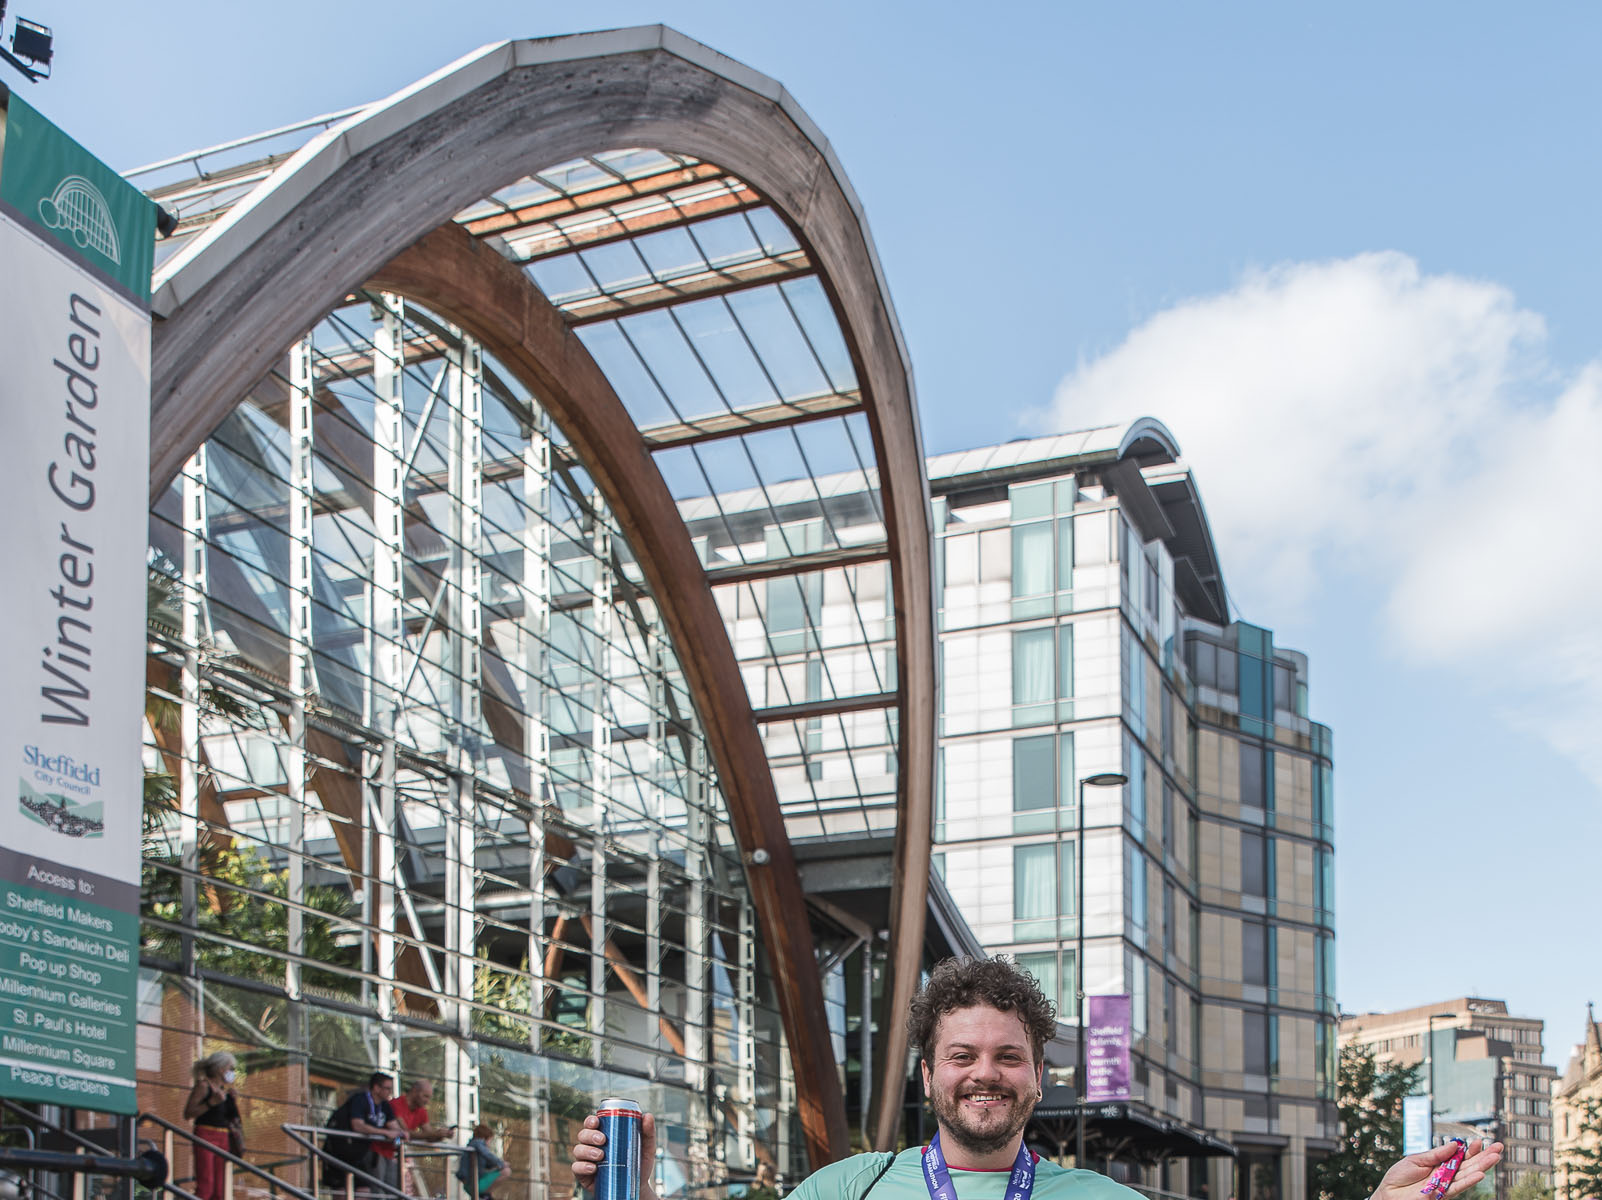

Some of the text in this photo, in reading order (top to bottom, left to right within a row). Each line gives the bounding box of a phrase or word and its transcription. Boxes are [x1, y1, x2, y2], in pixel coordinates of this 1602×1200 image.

[41, 293, 101, 727] Winter Garden
[24, 744, 100, 786] Sheffield
[34, 770, 91, 796] City Council
[27, 865, 95, 896] Access to:
[7, 892, 113, 932] Sheffield Makers
[43, 930, 103, 957] Sandwich
[105, 944, 129, 963] Deli
[20, 952, 101, 985] Pop up Shop
[0, 977, 122, 1017] Millennium Galleries
[13, 1008, 107, 1041] St. Paul's Hotel
[1090, 1027, 1123, 1036] Sheffield
[3, 1036, 116, 1070] Millennium Square
[11, 1065, 111, 1097] Peace Gardens
